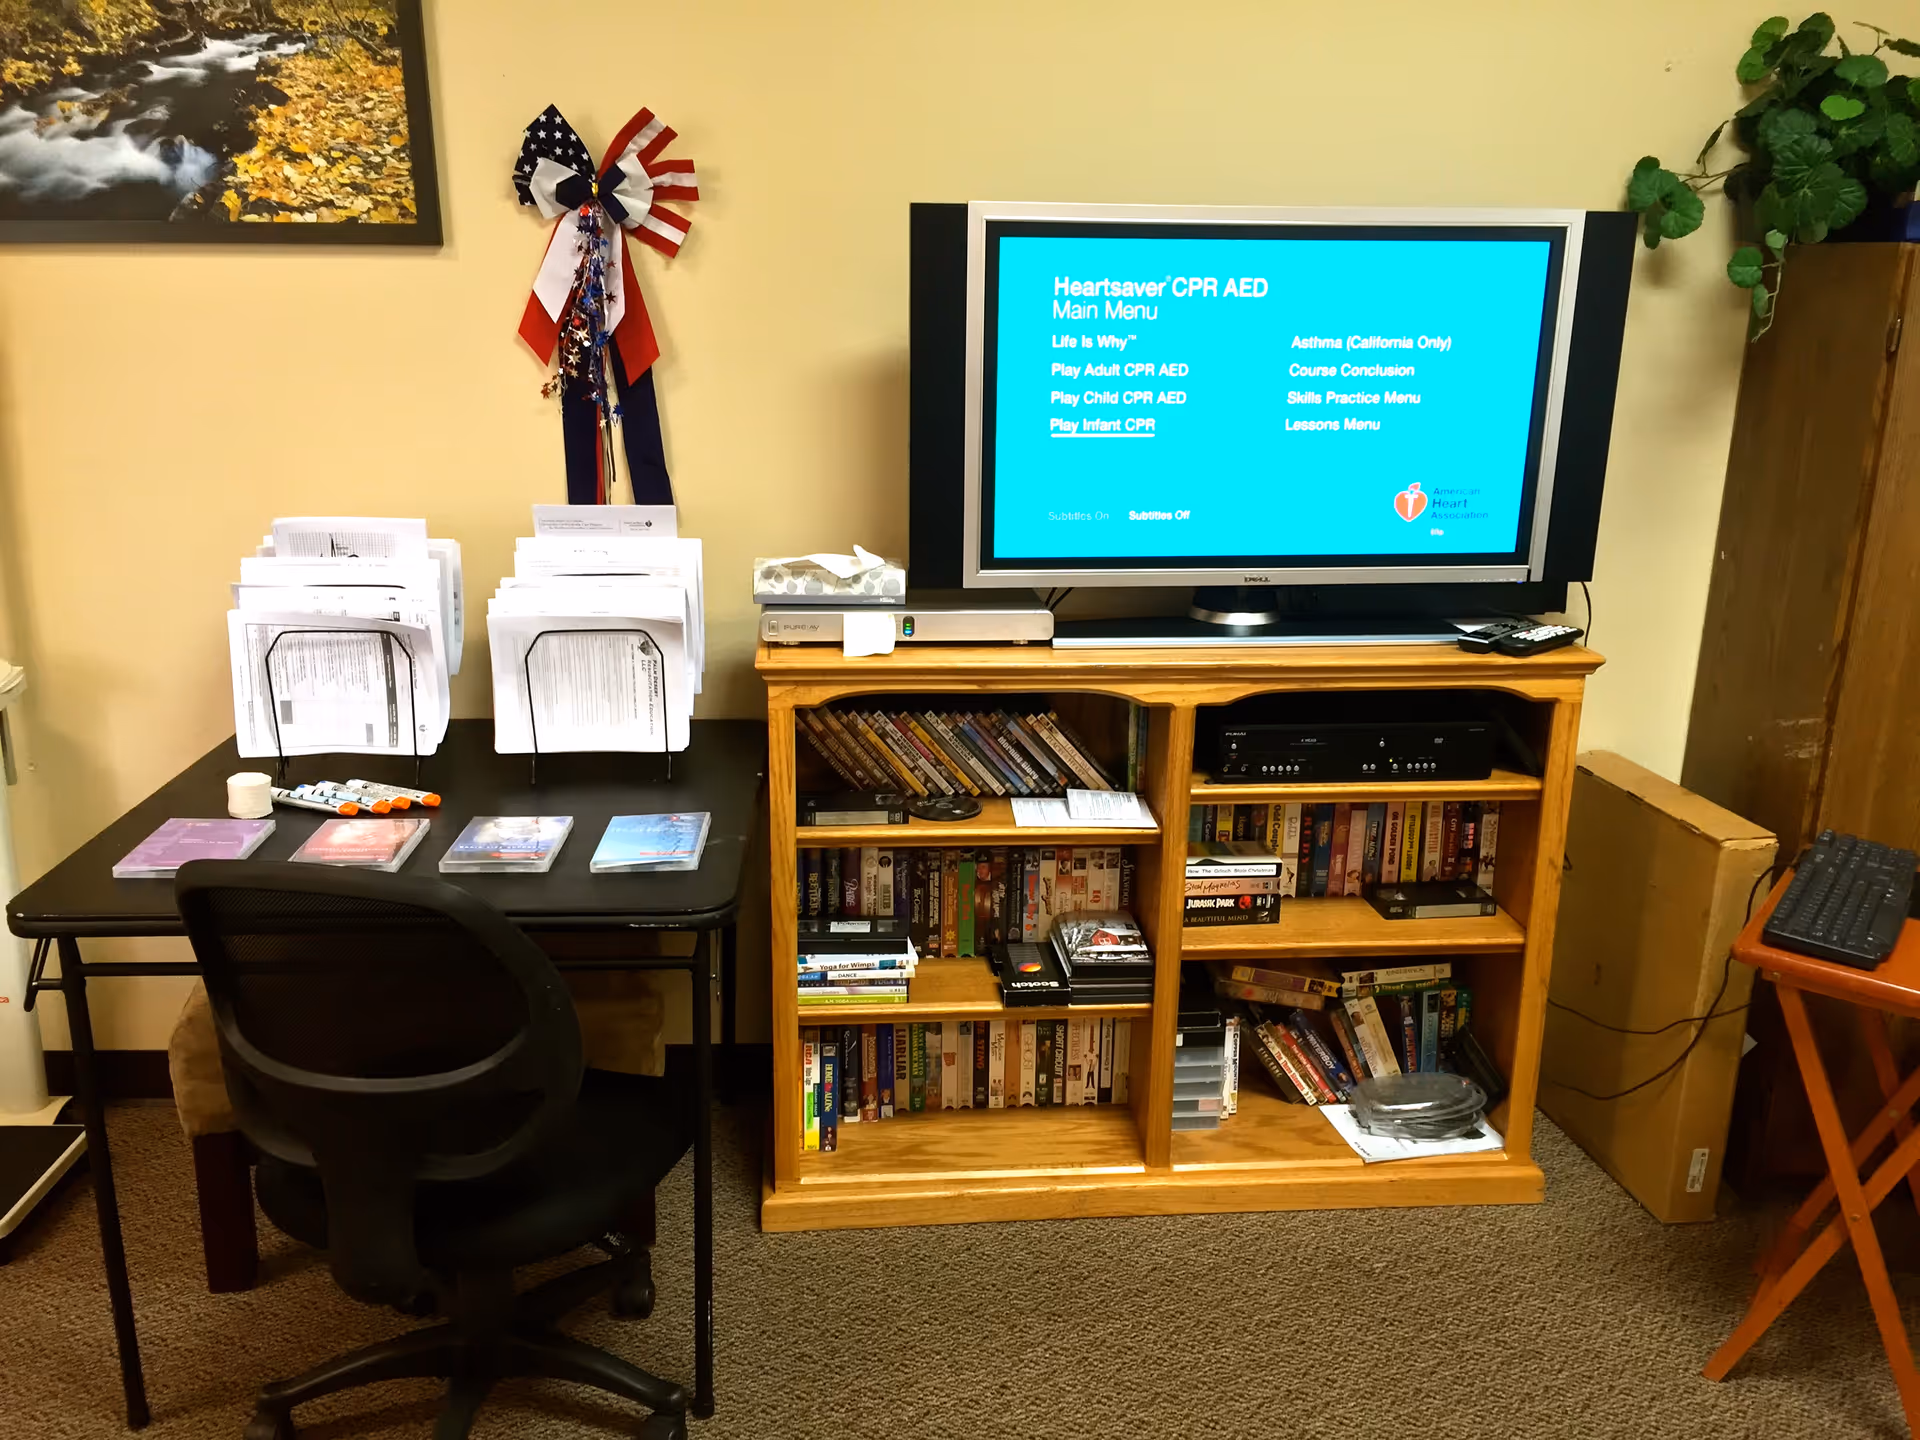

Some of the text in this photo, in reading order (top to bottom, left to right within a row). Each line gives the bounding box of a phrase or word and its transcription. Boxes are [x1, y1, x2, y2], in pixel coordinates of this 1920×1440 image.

[1172, 277, 1218, 297] CPR
[1223, 278, 1268, 297] AED
[1053, 300, 1158, 320] Main Menu
[1052, 335, 1077, 348] Life
[1082, 335, 1093, 348] Is
[1291, 335, 1452, 352] Asthma (California Only)
[1051, 363, 1189, 379] Play Adult CPR AED
[1289, 363, 1415, 377] Course Conclusion
[1050, 391, 1187, 407] Play Child CPR AED
[1287, 391, 1421, 404] Skills Practice Menu
[1050, 418, 1156, 434] Play Infant CPR
[1285, 418, 1381, 431] Lessons Menu
[1433, 488, 1480, 496] American
[1432, 499, 1468, 509] Heart
[1048, 511, 1109, 521] Subtitles On
[1129, 510, 1191, 521] Subtitles Off
[1431, 512, 1489, 520] Association
[1020, 760, 1039, 780] Glory
[1388, 848, 1396, 865] POND
[1186, 898, 1235, 909] JURASSIC PARK
[851, 961, 875, 969] Wimps
[1055, 1024, 1064, 1076] SHORT CIRCUIT
[1305, 1032, 1336, 1072] WATERBOY
[825, 1064, 833, 1083] HOME
